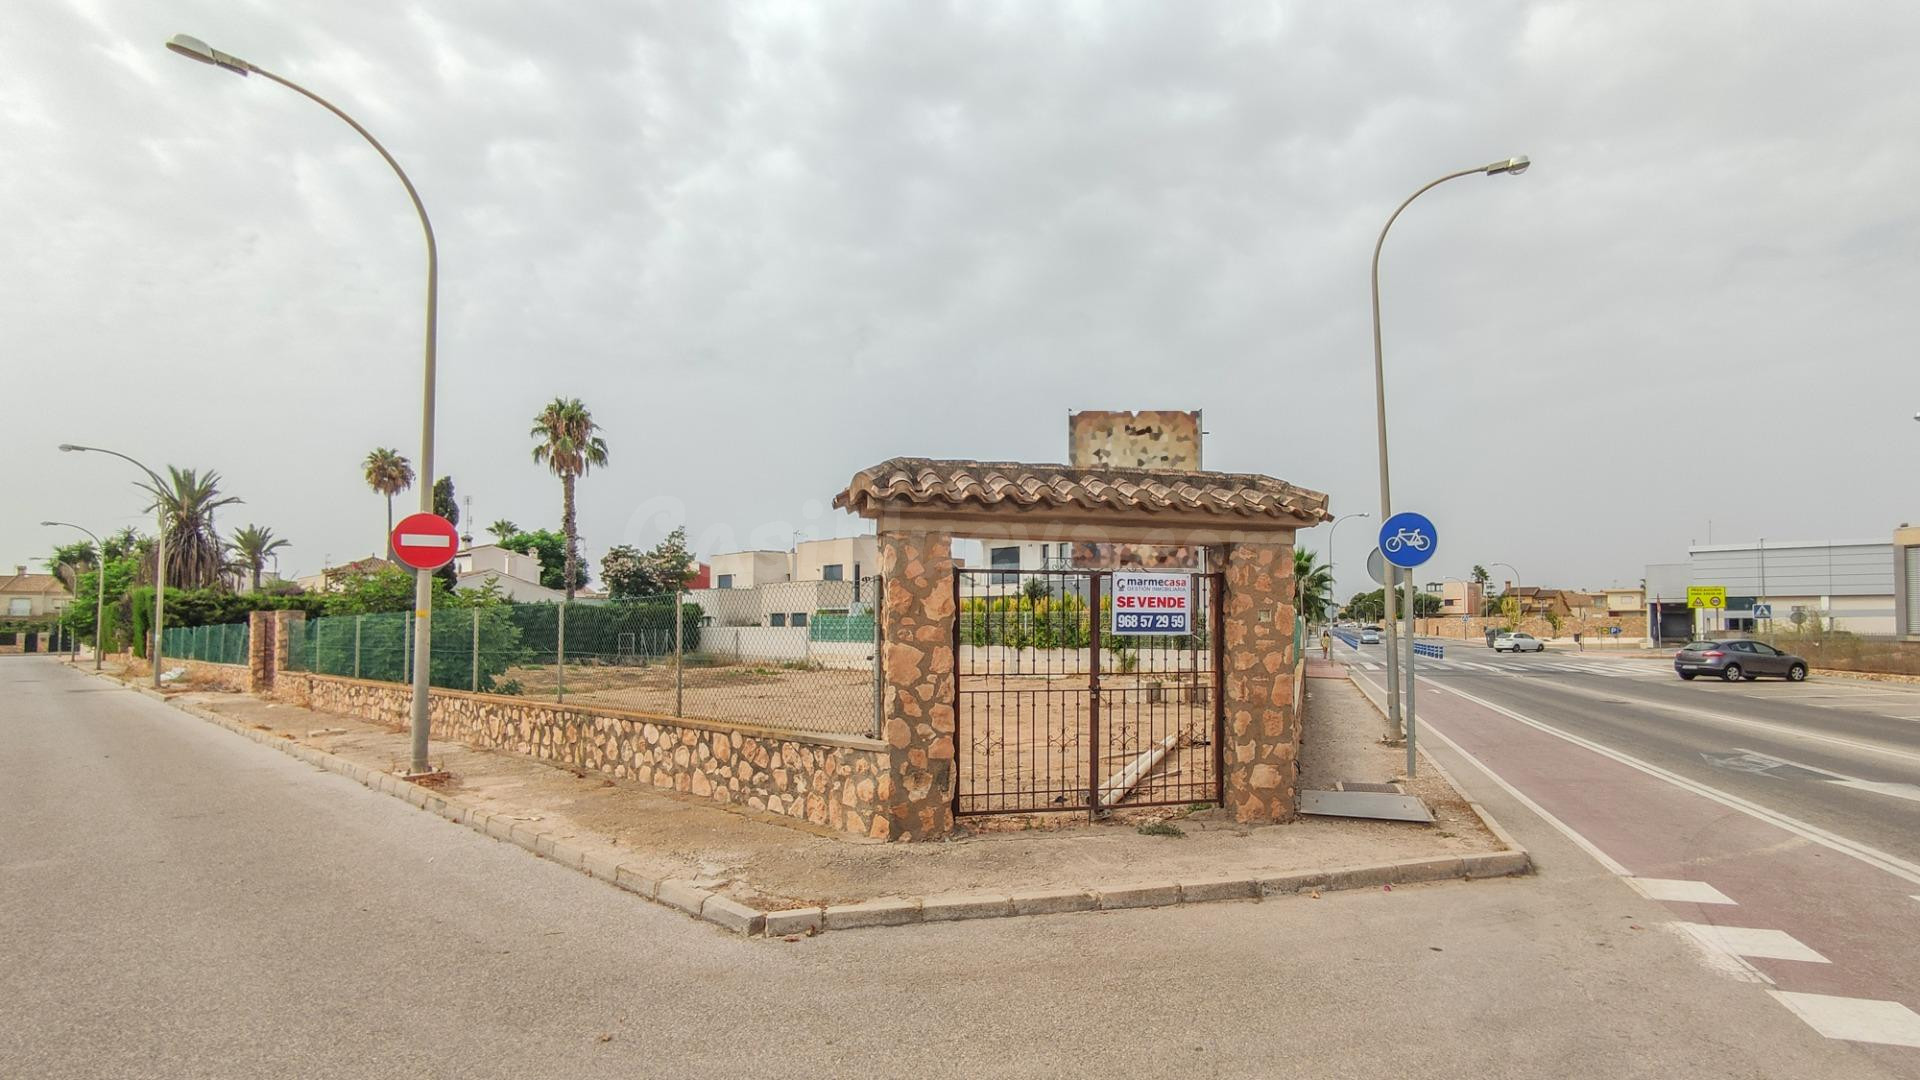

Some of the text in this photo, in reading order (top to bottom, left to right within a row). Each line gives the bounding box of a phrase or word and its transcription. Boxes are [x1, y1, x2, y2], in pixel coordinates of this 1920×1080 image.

[1127, 578, 1186, 587] marmecasa
[1117, 596, 1185, 608] SE VENDE
[1118, 615, 1184, 628] 968 57 29 59
